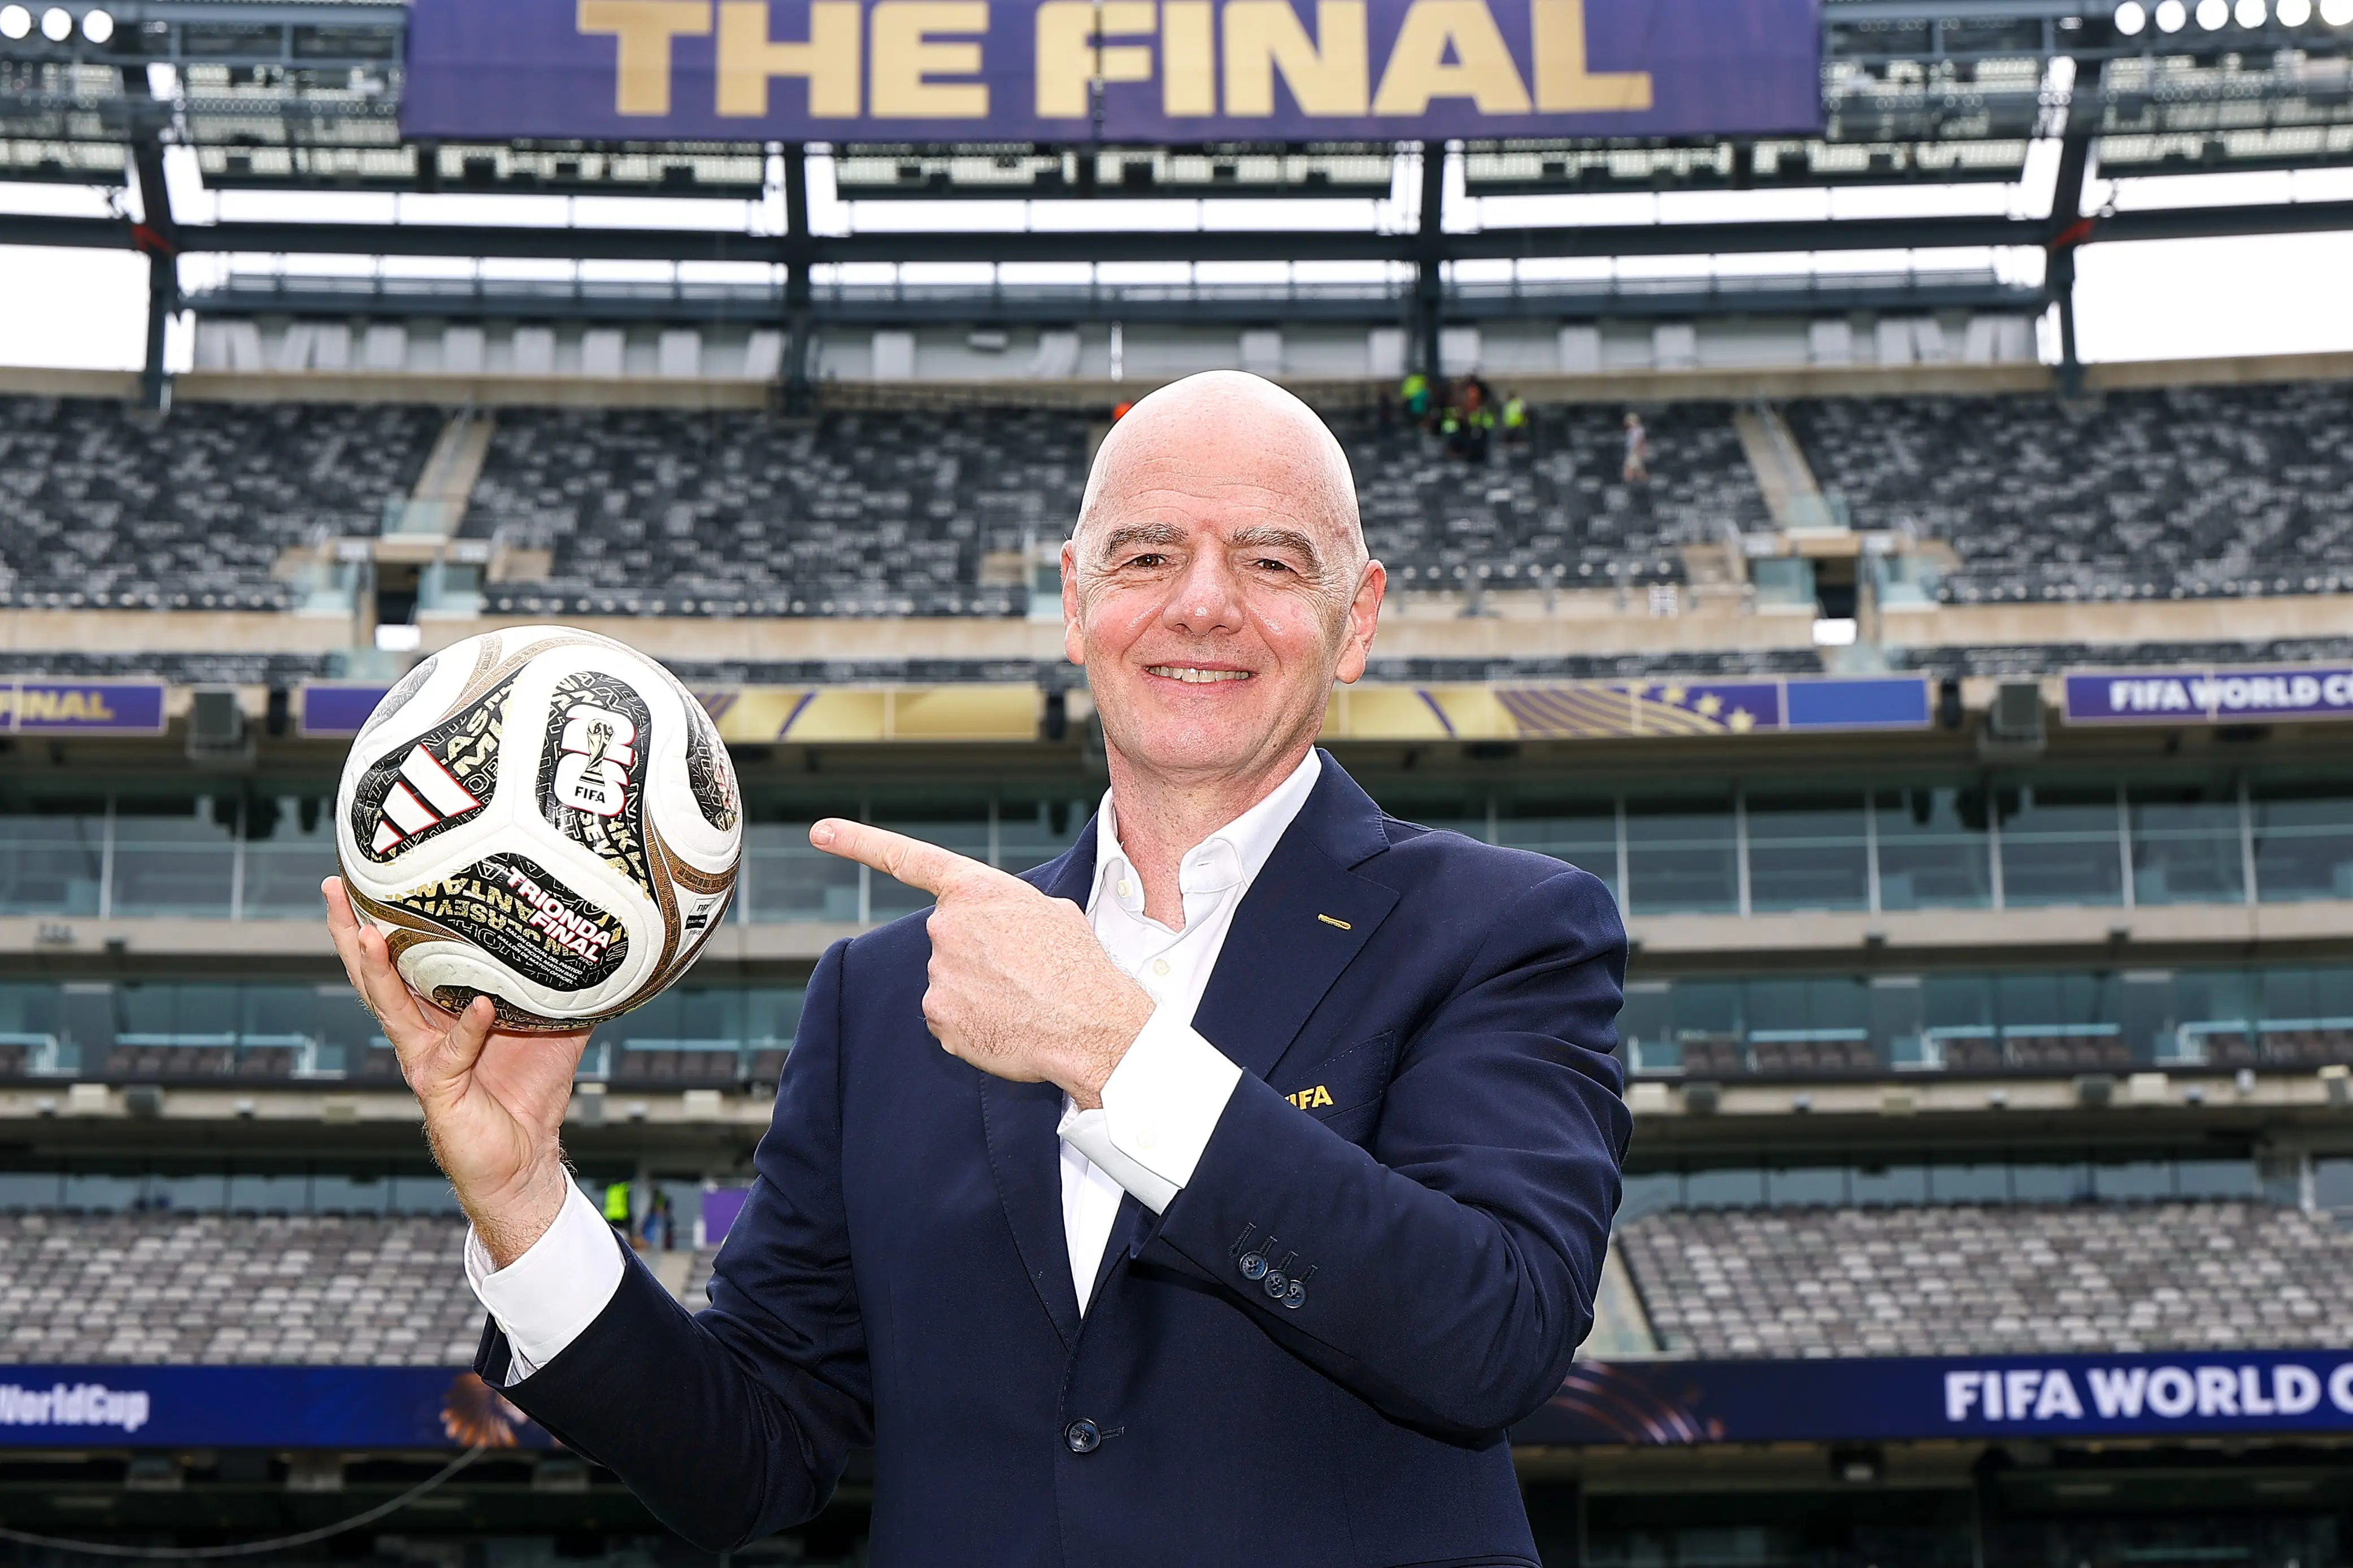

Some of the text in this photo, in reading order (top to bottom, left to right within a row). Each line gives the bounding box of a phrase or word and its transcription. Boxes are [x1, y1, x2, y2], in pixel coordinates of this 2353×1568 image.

[578, 0, 1652, 117] THE FINAL
[2110, 678, 2190, 711] FIFA
[2190, 675, 2321, 710] WORLD
[574, 785, 606, 804] FIFA
[507, 865, 611, 949] TRIONDA
[529, 909, 599, 962] FINAL
[497, 935, 521, 954] BALLON
[520, 950, 529, 960] DE
[528, 955, 551, 973] MATCH
[550, 969, 574, 985] OFFICIEL
[517, 942, 578, 981] OFFICIAL MATCH BALL
[525, 939, 548, 959] OFICIAL
[547, 952, 559, 965] DEL
[559, 960, 583, 975] PARTIDO
[577, 956, 593, 966] PRO
[1284, 1085, 1334, 1110] IFA
[1945, 1368, 2085, 1421] FIFA
[2086, 1364, 2322, 1418] WORLD
